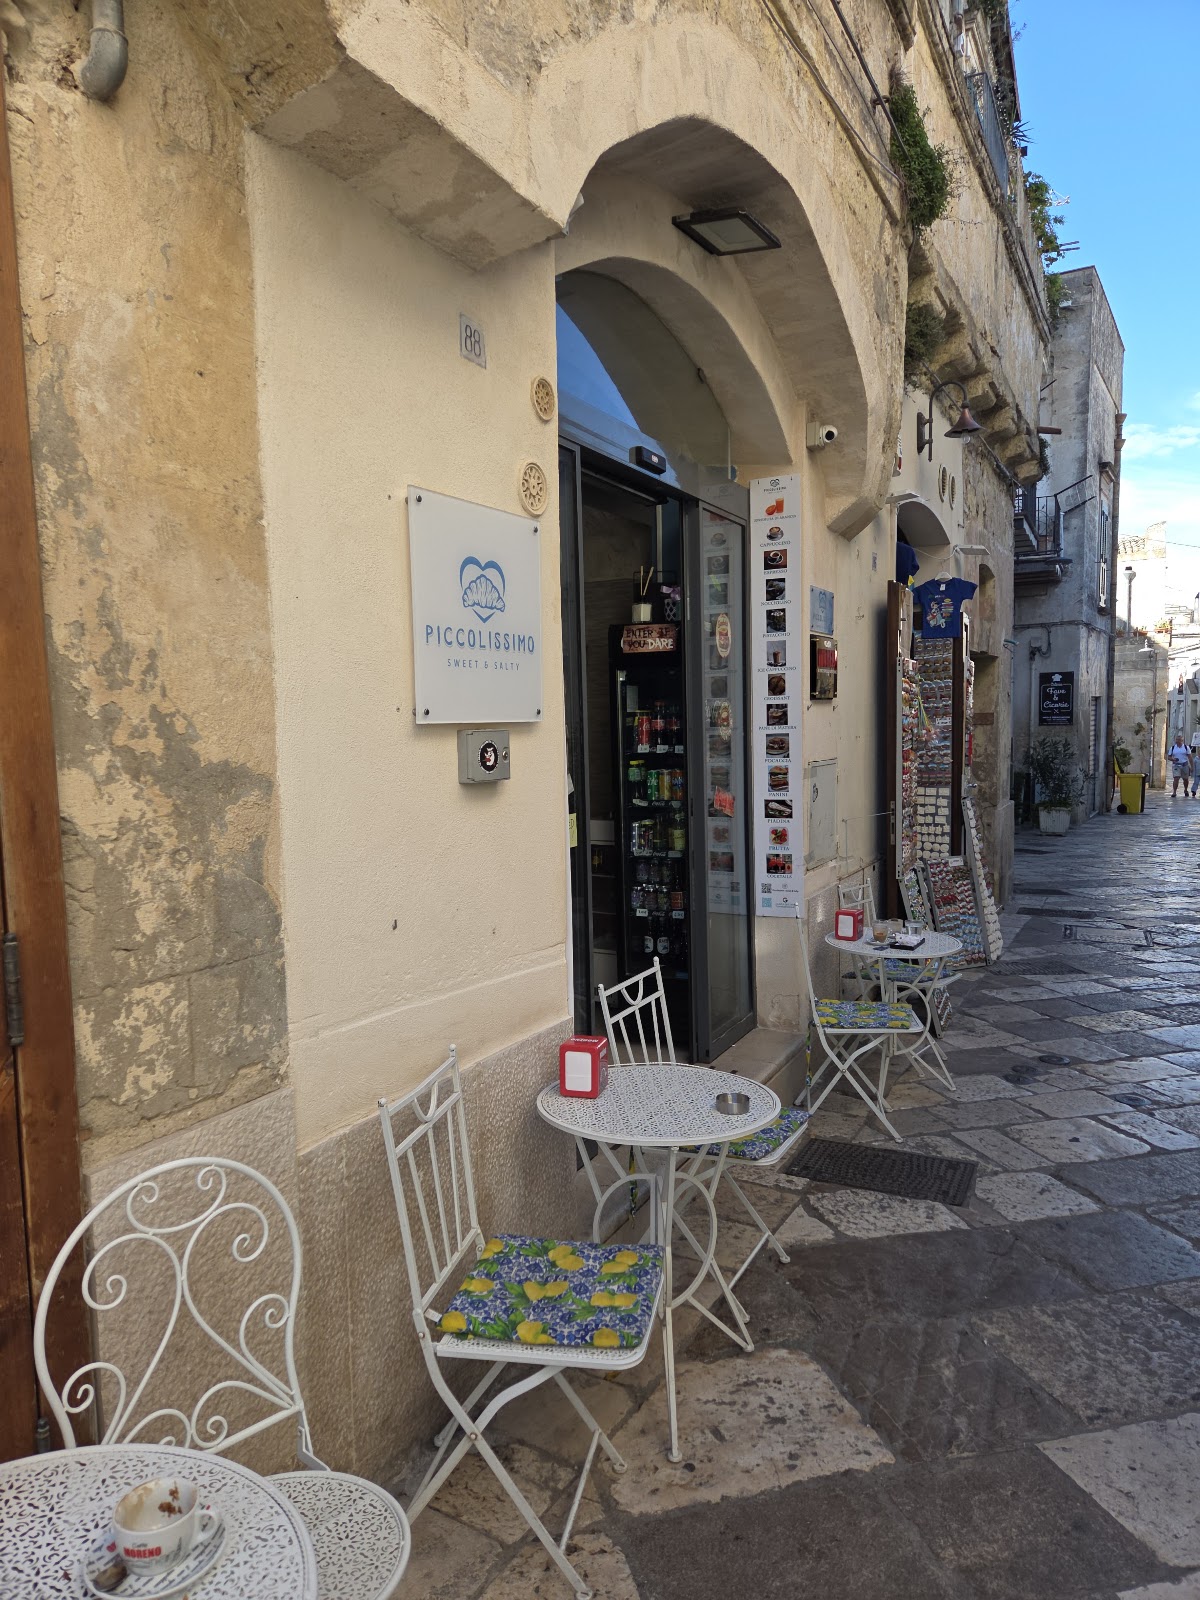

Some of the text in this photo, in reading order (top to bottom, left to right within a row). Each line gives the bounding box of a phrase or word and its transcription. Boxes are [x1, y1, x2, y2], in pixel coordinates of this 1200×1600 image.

[464, 324, 482, 357] 88
[425, 624, 535, 655] PICCOLISSIMO
[626, 629, 653, 639] ENTER
[627, 637, 674, 650] YOU DARE
[447, 658, 520, 671] SWEET & SALTY
[123, 1545, 162, 1560] MORENO
